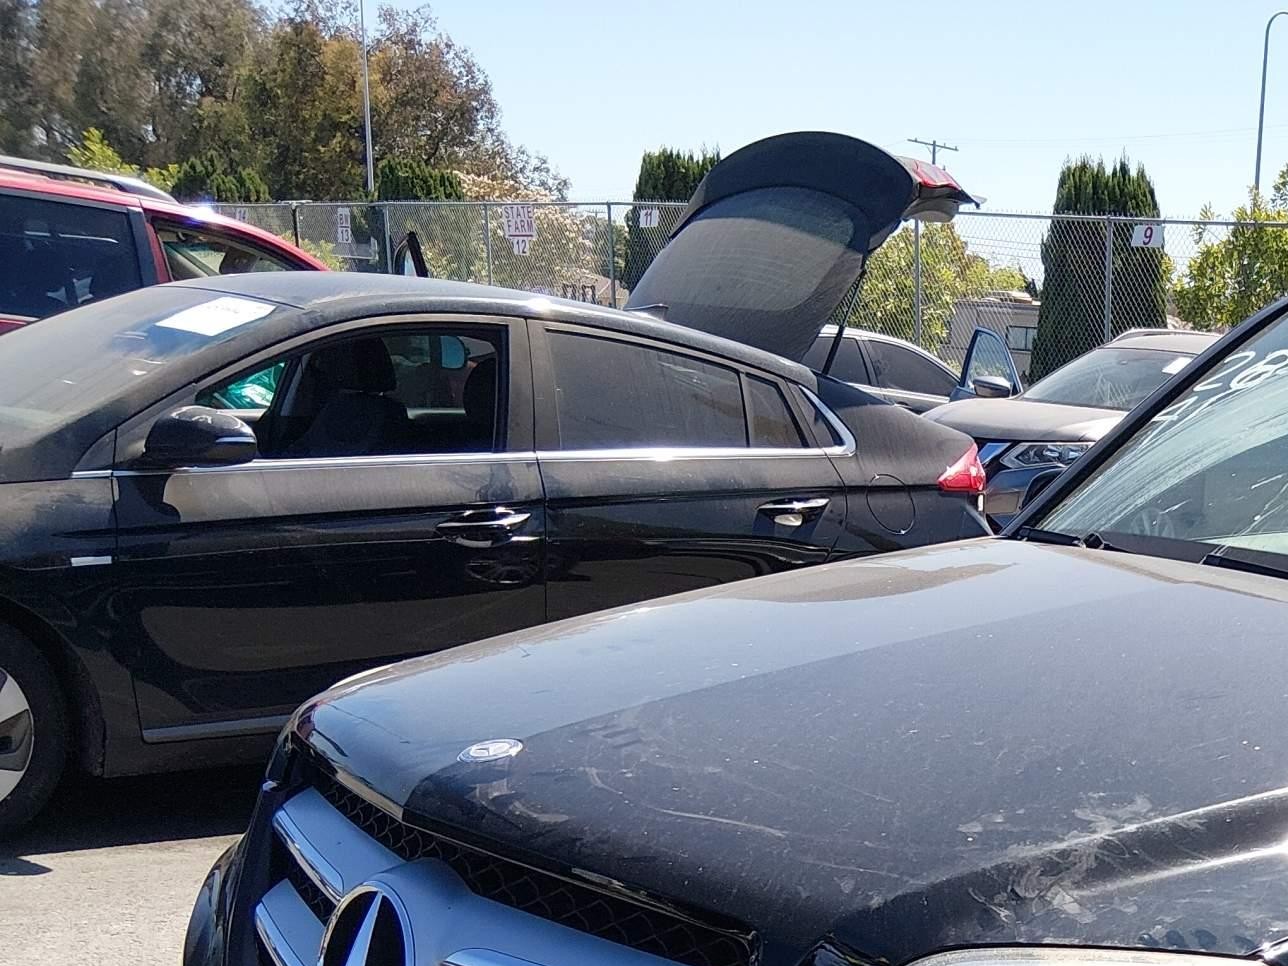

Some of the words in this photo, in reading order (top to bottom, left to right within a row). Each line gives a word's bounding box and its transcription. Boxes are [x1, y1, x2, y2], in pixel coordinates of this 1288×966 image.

[503, 206, 533, 219] STATE
[644, 210, 653, 226] 11
[506, 219, 534, 233] FARM
[340, 229, 350, 242] 13
[1142, 226, 1154, 246] 9
[515, 239, 527, 254] 12
